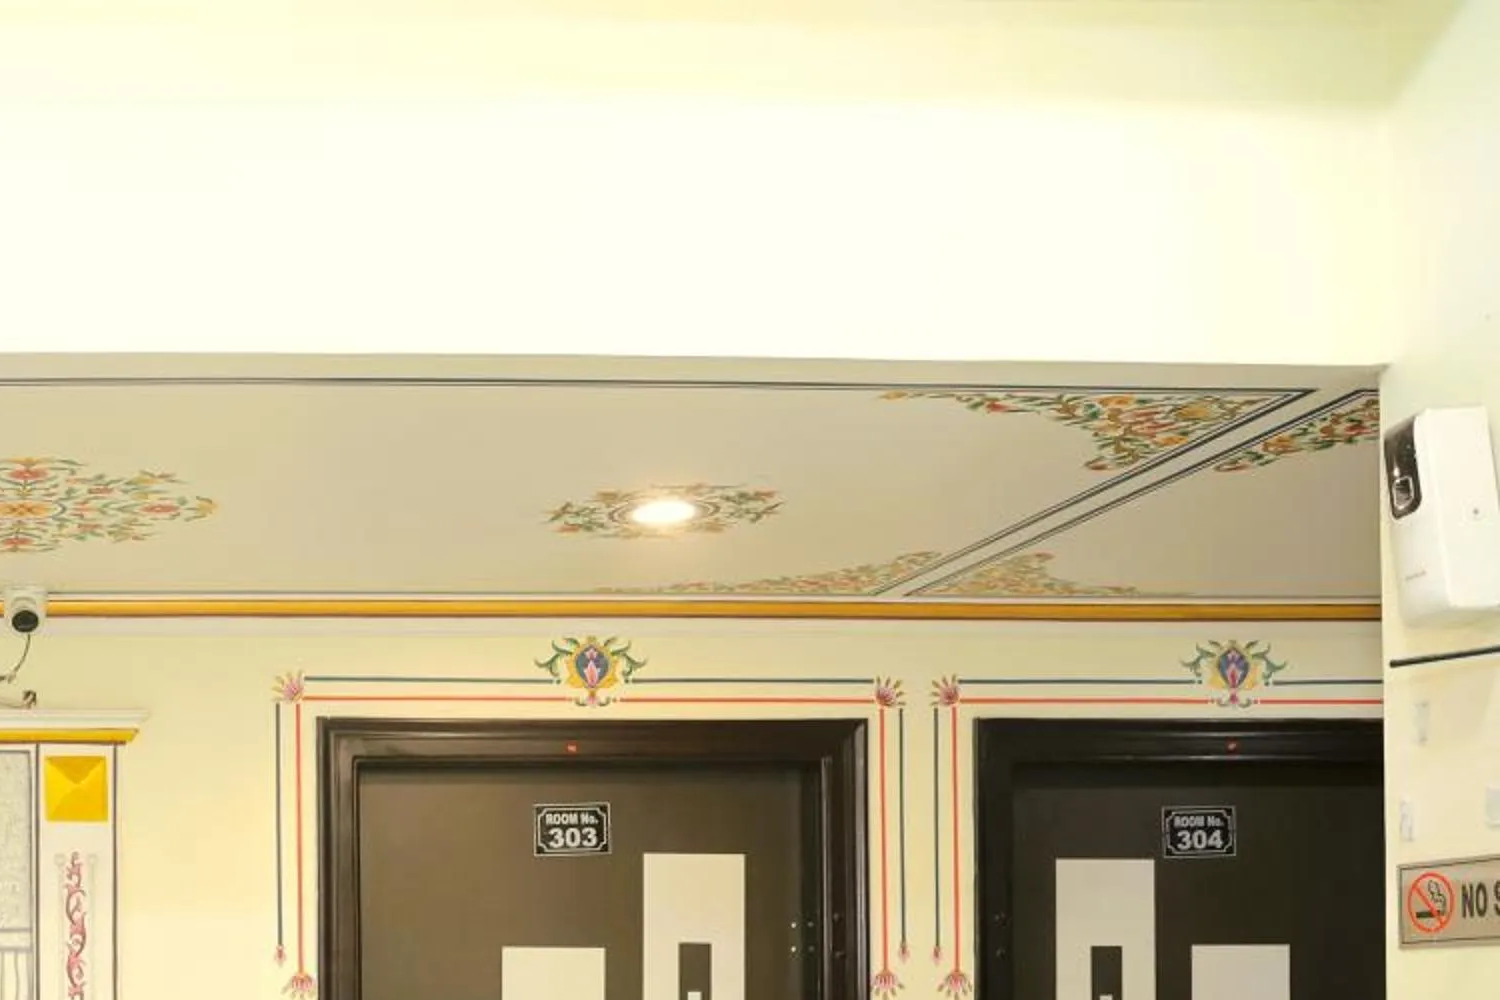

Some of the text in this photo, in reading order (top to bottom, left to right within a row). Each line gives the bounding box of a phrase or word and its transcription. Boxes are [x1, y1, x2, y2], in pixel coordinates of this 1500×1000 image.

[545, 812, 578, 825] ROOM
[548, 827, 598, 848] 303
[1177, 829, 1224, 850] 304
[1461, 881, 1488, 918] NO
